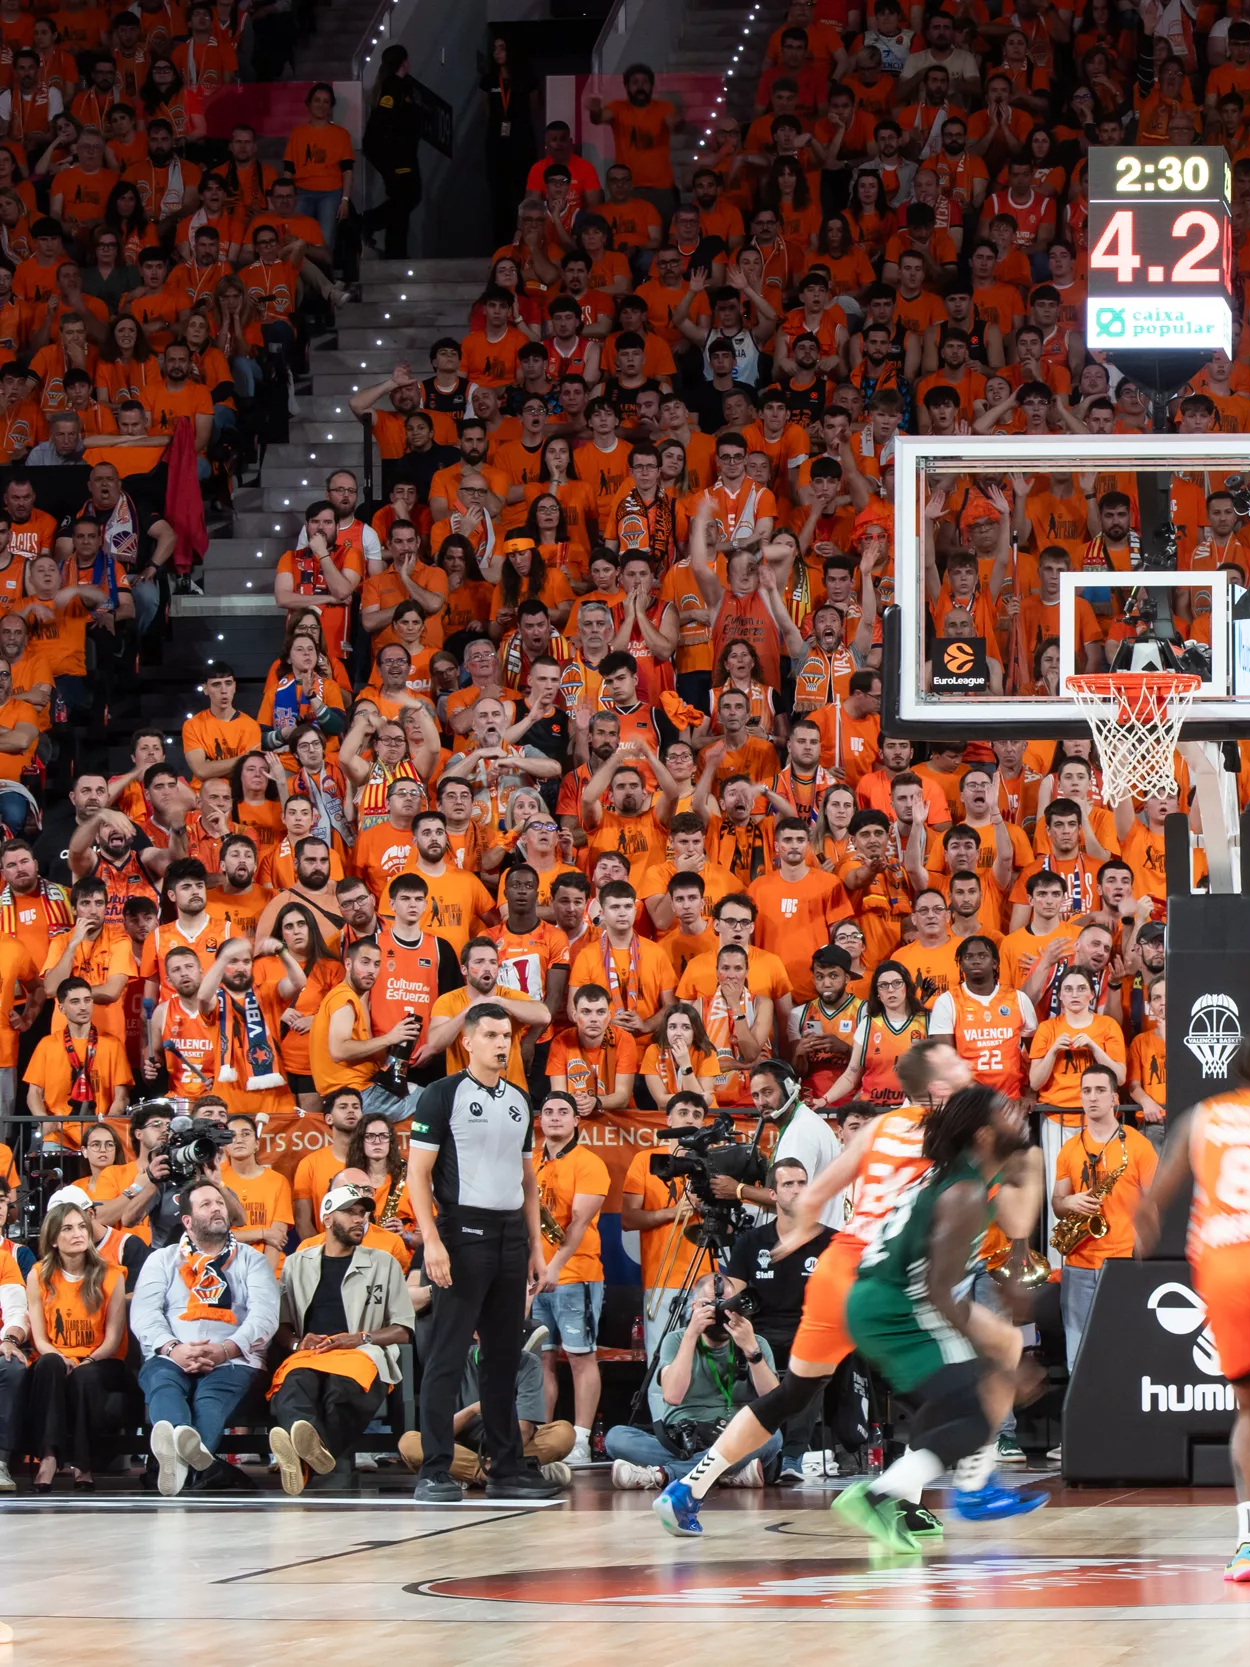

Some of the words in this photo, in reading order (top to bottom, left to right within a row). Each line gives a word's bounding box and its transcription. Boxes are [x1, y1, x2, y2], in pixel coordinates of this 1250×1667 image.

[1116, 156, 1209, 192] 2:30
[1090, 210, 1221, 283] 4.2
[1133, 308, 1184, 321] caixa
[1133, 322, 1215, 337] popular
[933, 676, 985, 687] EuroLeague
[781, 898, 798, 912] VBC
[387, 977, 422, 991] Cultura
[386, 989, 430, 1004] Esfuerzo
[963, 1027, 1013, 1042] VALENCIA
[977, 1039, 1002, 1048] BASKET
[977, 1050, 1003, 1070] 22
[755, 1270, 774, 1279] Staff
